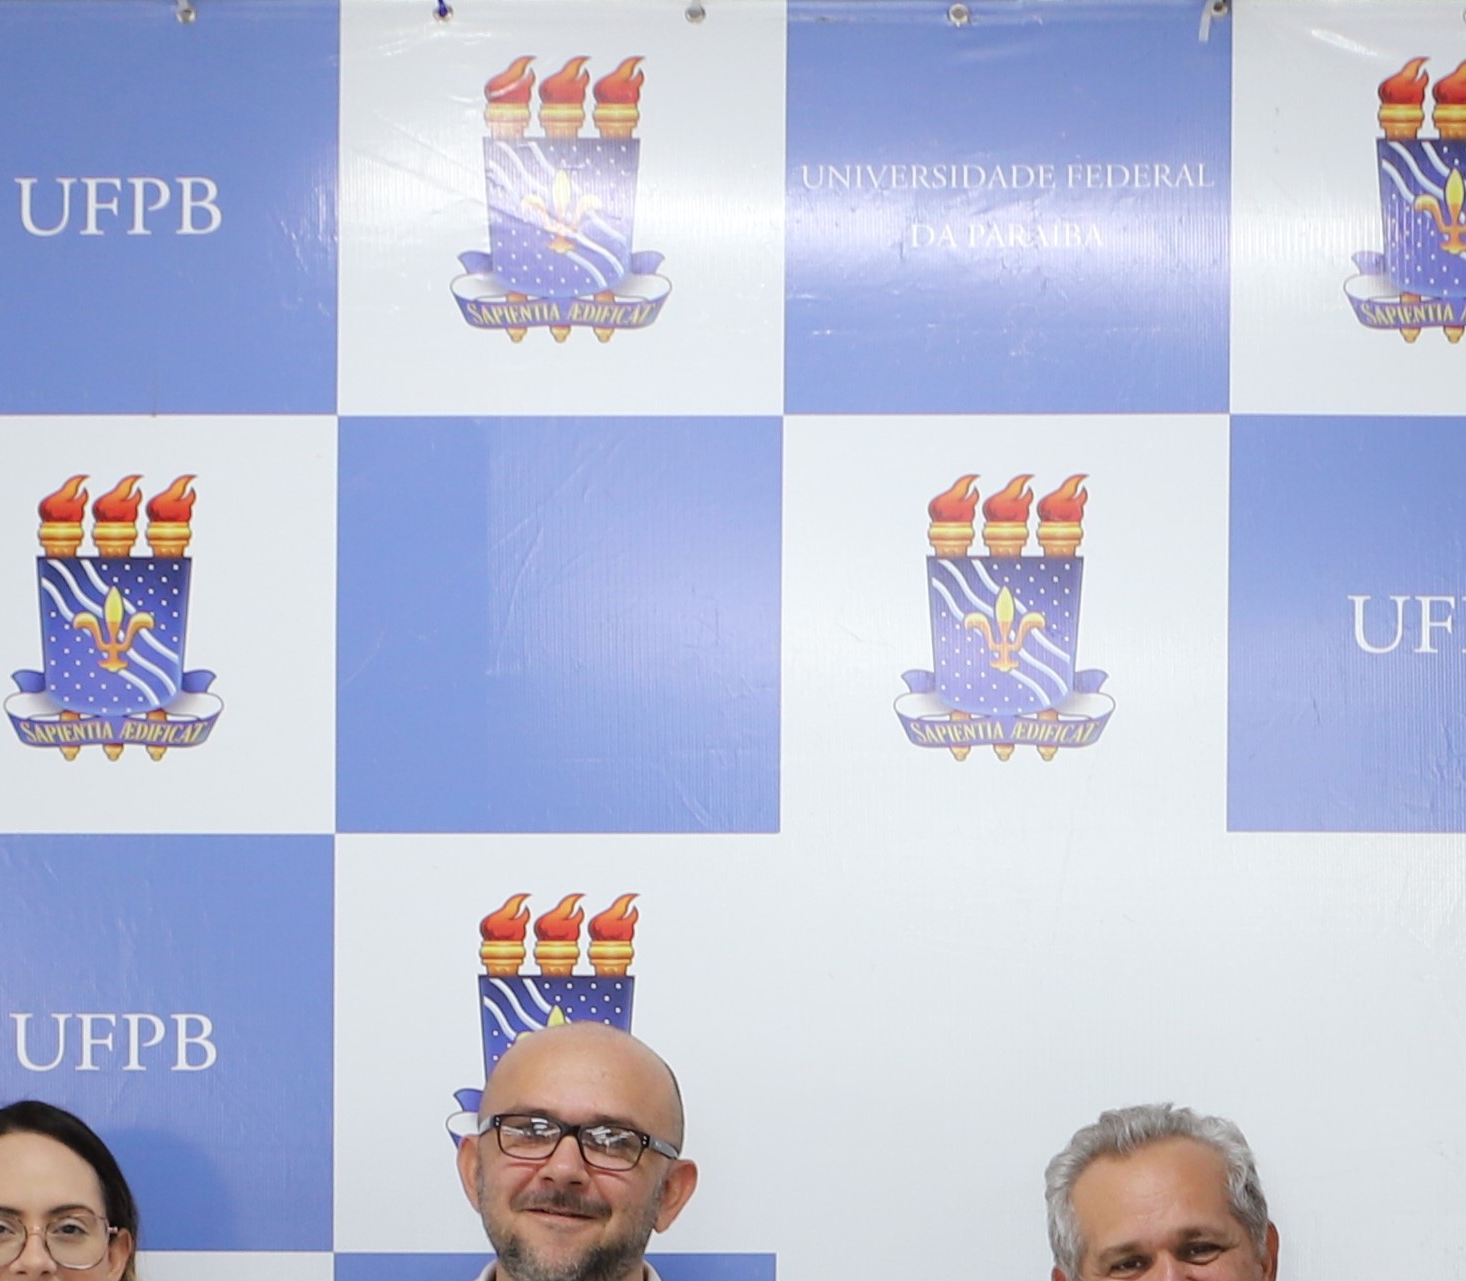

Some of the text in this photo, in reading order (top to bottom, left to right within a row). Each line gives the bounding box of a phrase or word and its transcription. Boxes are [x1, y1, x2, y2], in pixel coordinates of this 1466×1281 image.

[801, 163, 1216, 190] UNIVERSIDADE FEDERAL
[16, 176, 223, 237] UFPB
[910, 223, 956, 249] DA
[467, 303, 654, 326] SAPIENTIA ÆDIFICAT
[1361, 304, 1455, 327] SAPIENTIA
[20, 721, 207, 744] SAPIENTIA ÆDIFICAT
[910, 721, 1097, 744] SAPIENTIA ÆDIFICAT
[11, 1012, 218, 1073] UFPB
